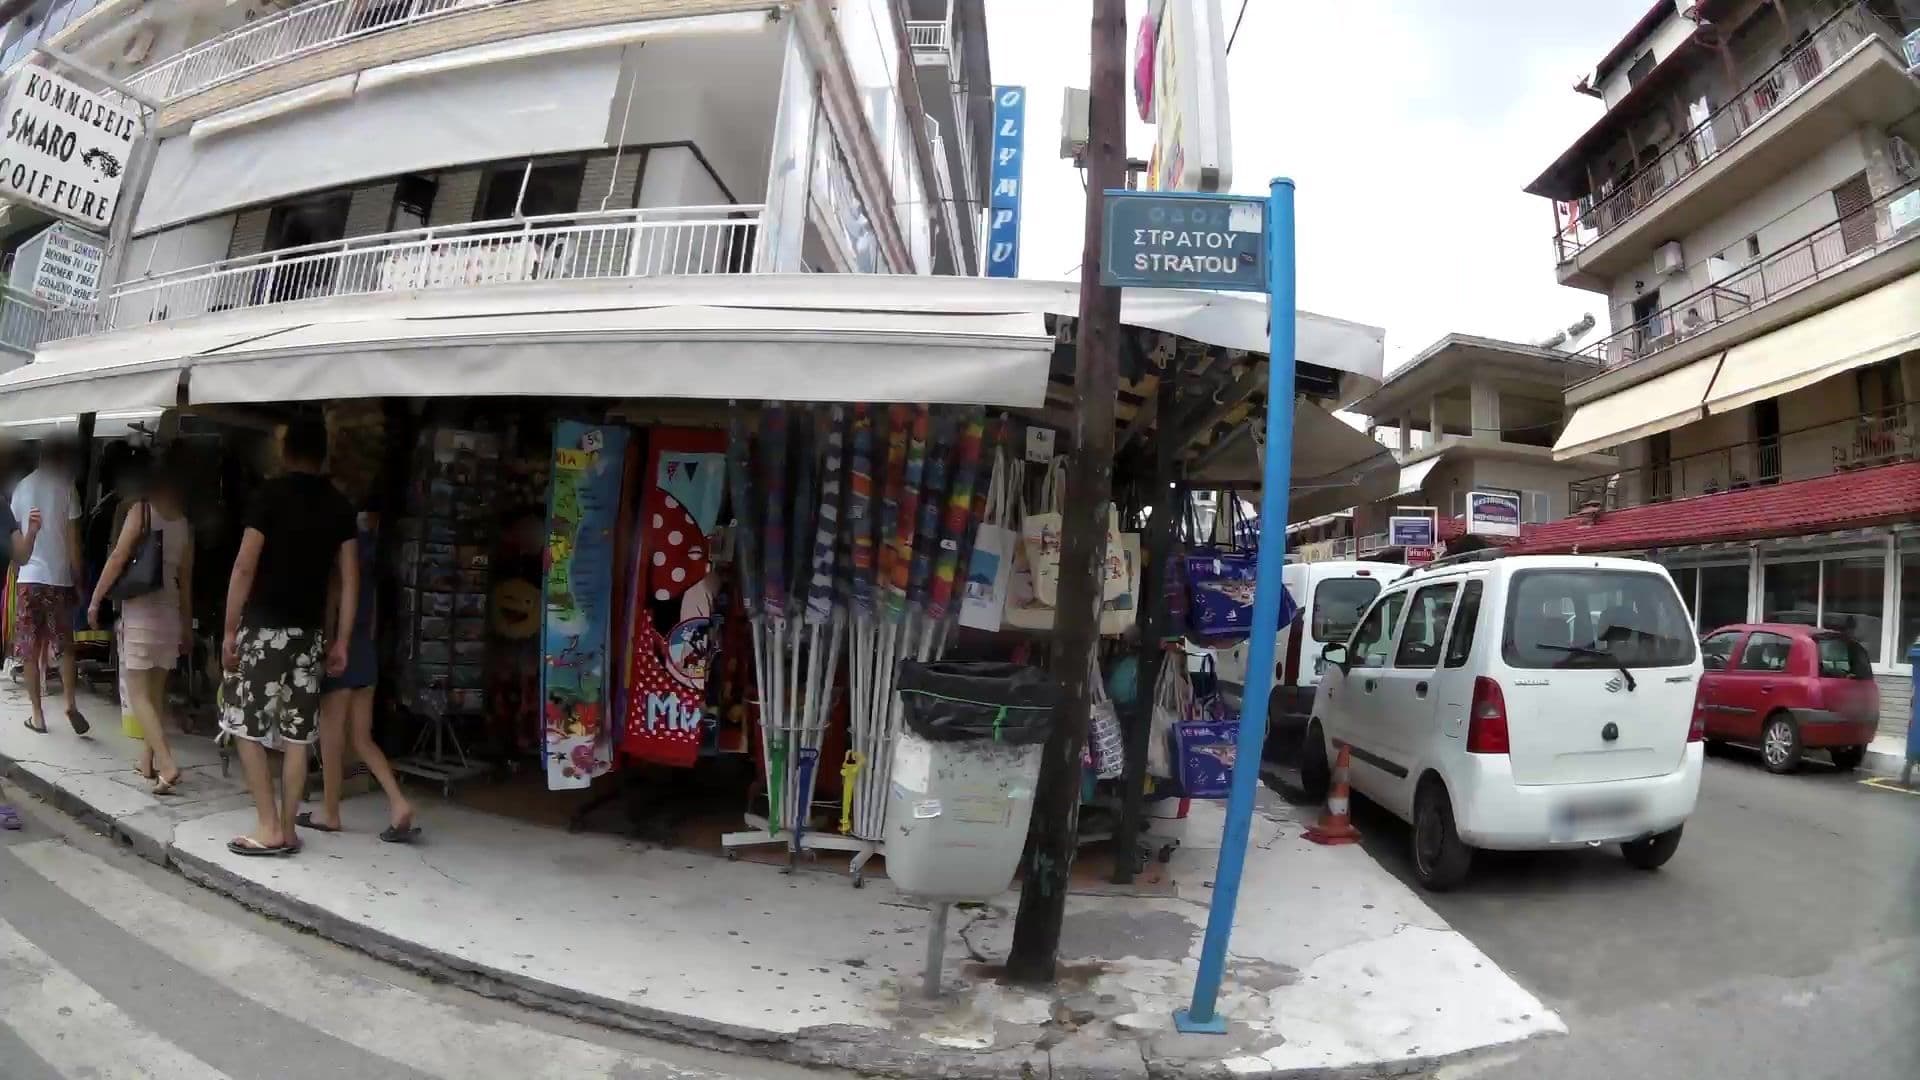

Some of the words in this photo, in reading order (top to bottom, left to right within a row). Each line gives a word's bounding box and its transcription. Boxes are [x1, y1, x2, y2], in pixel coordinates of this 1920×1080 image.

[25, 73, 135, 142] ΚΟΜΜΩΣΕΙΣ
[7, 108, 77, 163] SMARO
[0, 157, 109, 220] COIFFURE
[1133, 229, 1238, 249] ΣΤΡΑΤΟΥ
[1134, 253, 1237, 273] STRATOU
